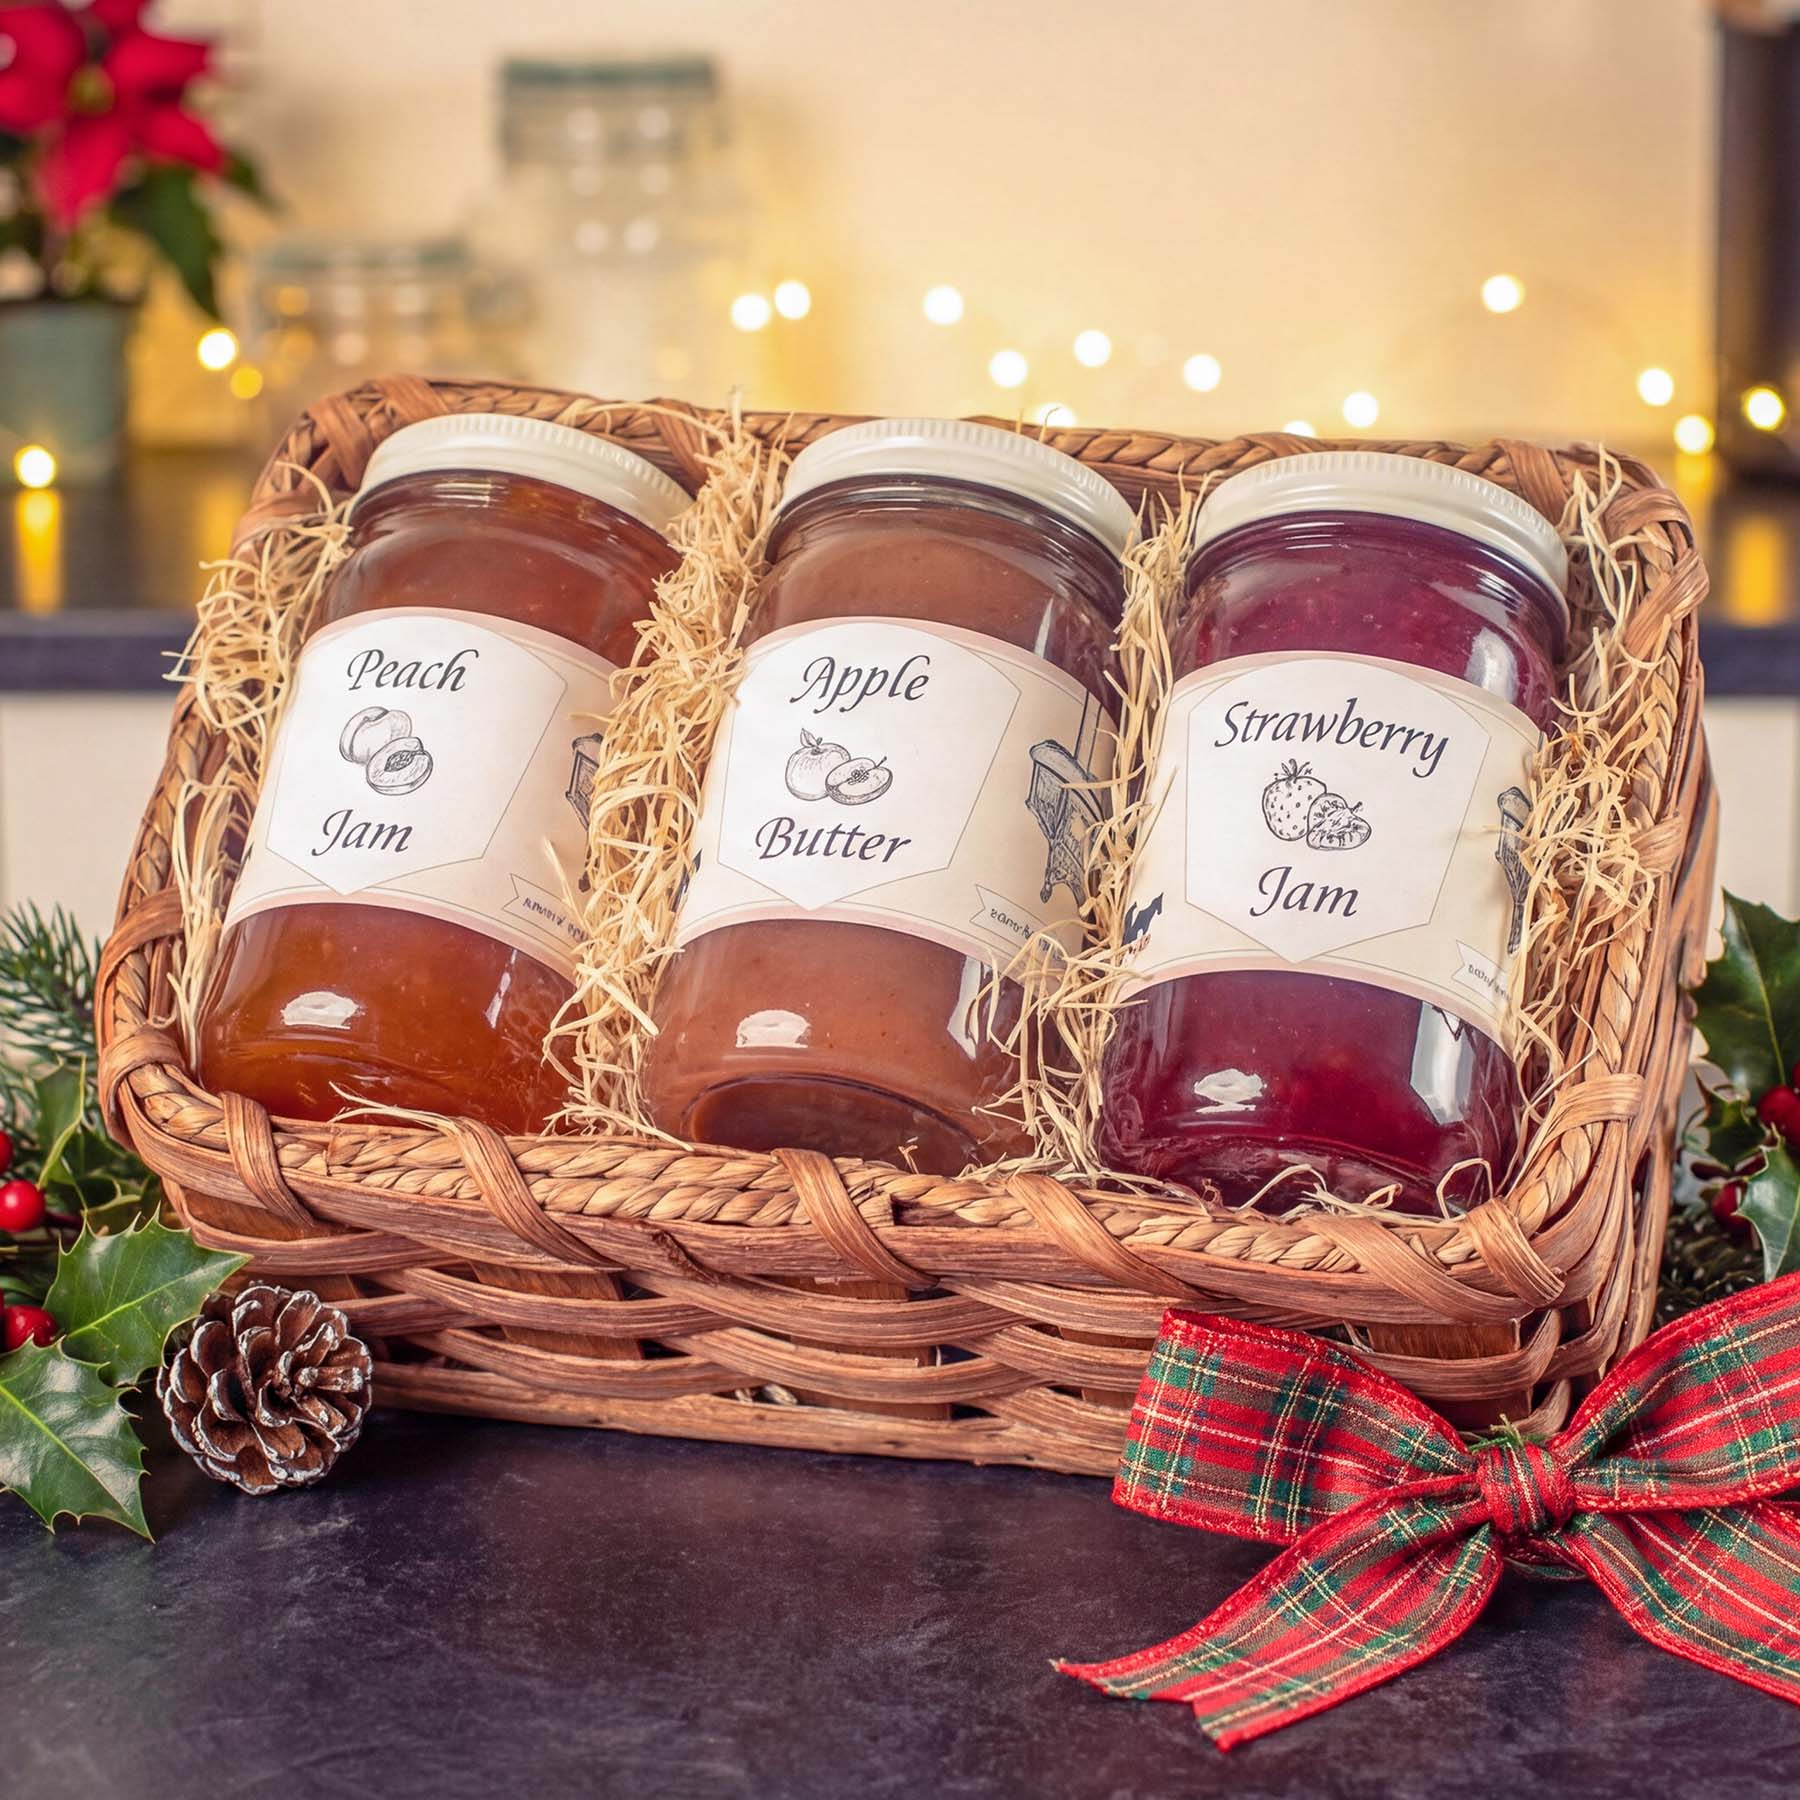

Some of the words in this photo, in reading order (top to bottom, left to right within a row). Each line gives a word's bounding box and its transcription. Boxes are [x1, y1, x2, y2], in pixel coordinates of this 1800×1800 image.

[348, 649, 479, 691] Peach
[790, 655, 930, 714] Apple
[1214, 697, 1448, 778] Strawberry
[312, 809, 413, 857] Jam
[755, 817, 911, 862] Butter
[1250, 867, 1358, 917] Jam
